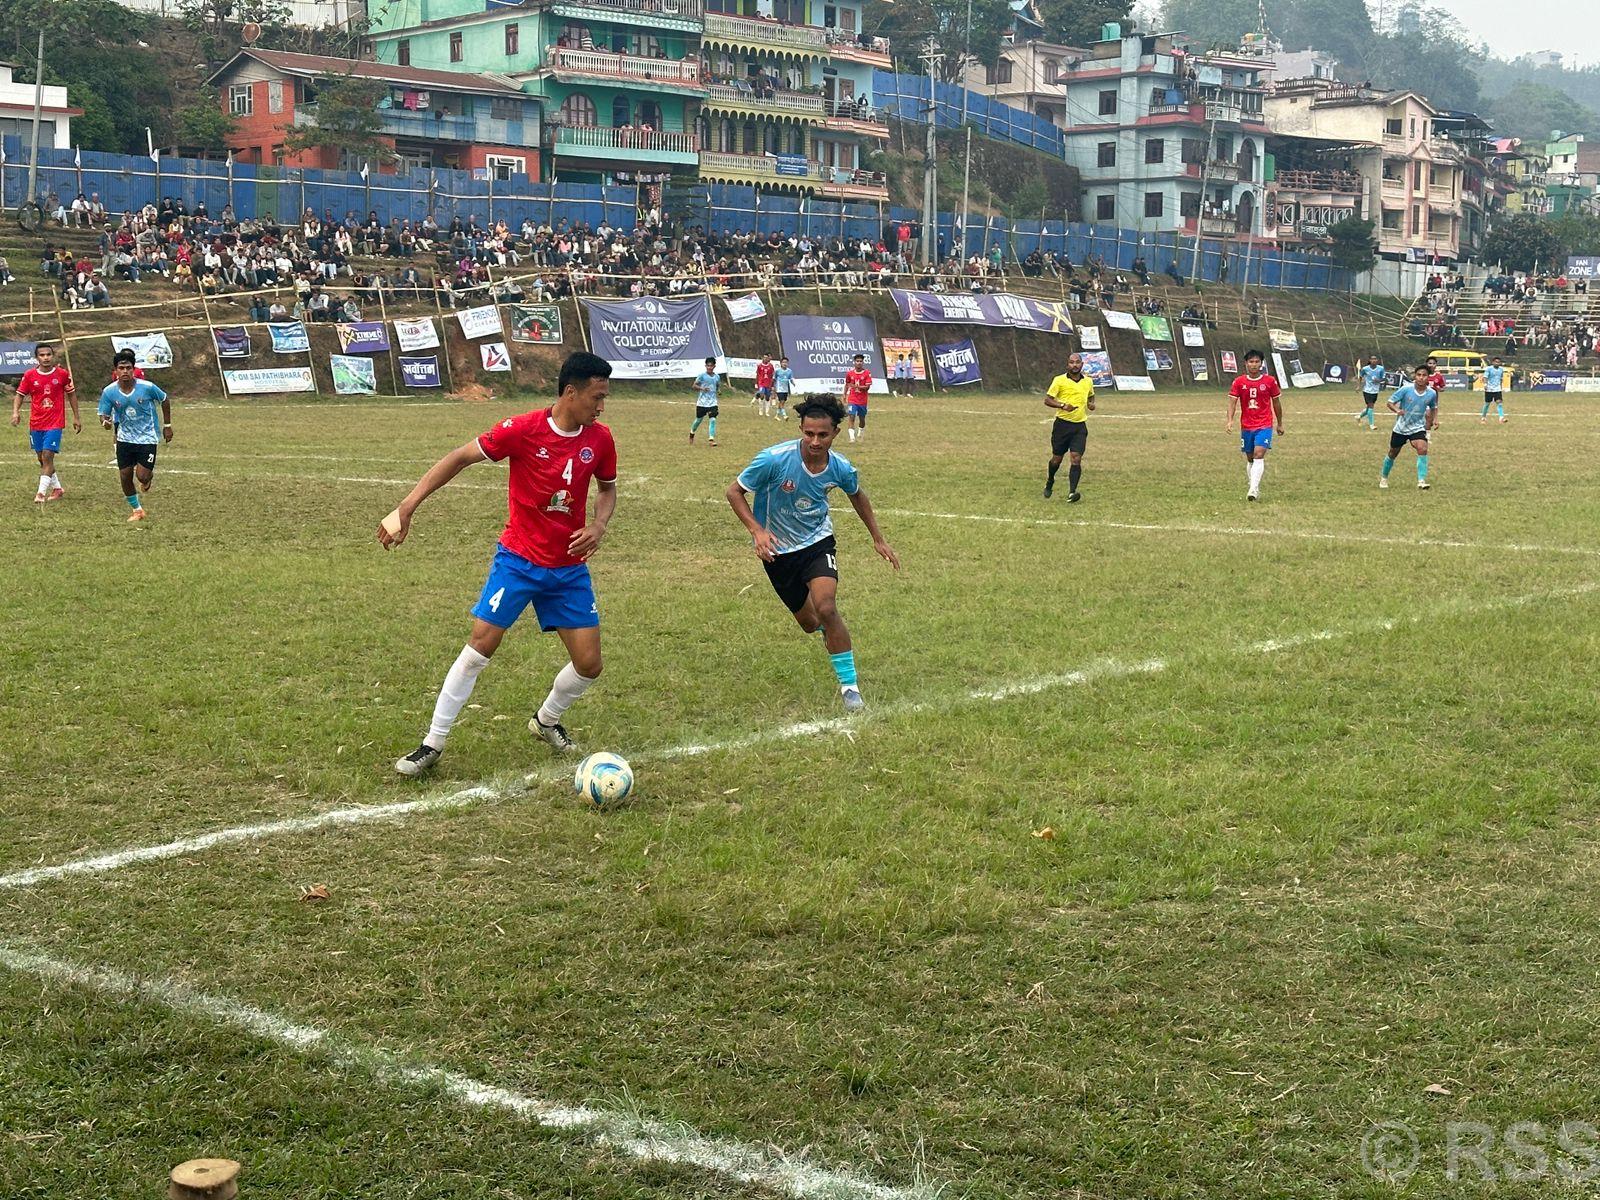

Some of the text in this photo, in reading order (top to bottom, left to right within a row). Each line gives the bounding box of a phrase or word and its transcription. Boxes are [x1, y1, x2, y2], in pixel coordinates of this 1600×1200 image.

[1568, 266, 1593, 275] ZONE
[600, 320, 696, 333] INVITATIONAL ILAM
[796, 340, 857, 351] INVITATIONAL
[858, 340, 875, 352] ILAM
[649, 348, 673, 356] EDITION
[238, 373, 248, 381] OM
[250, 372, 260, 380] SAI
[1249, 387, 1257, 398] 13
[562, 458, 573, 485] 4
[488, 587, 505, 613] 4
